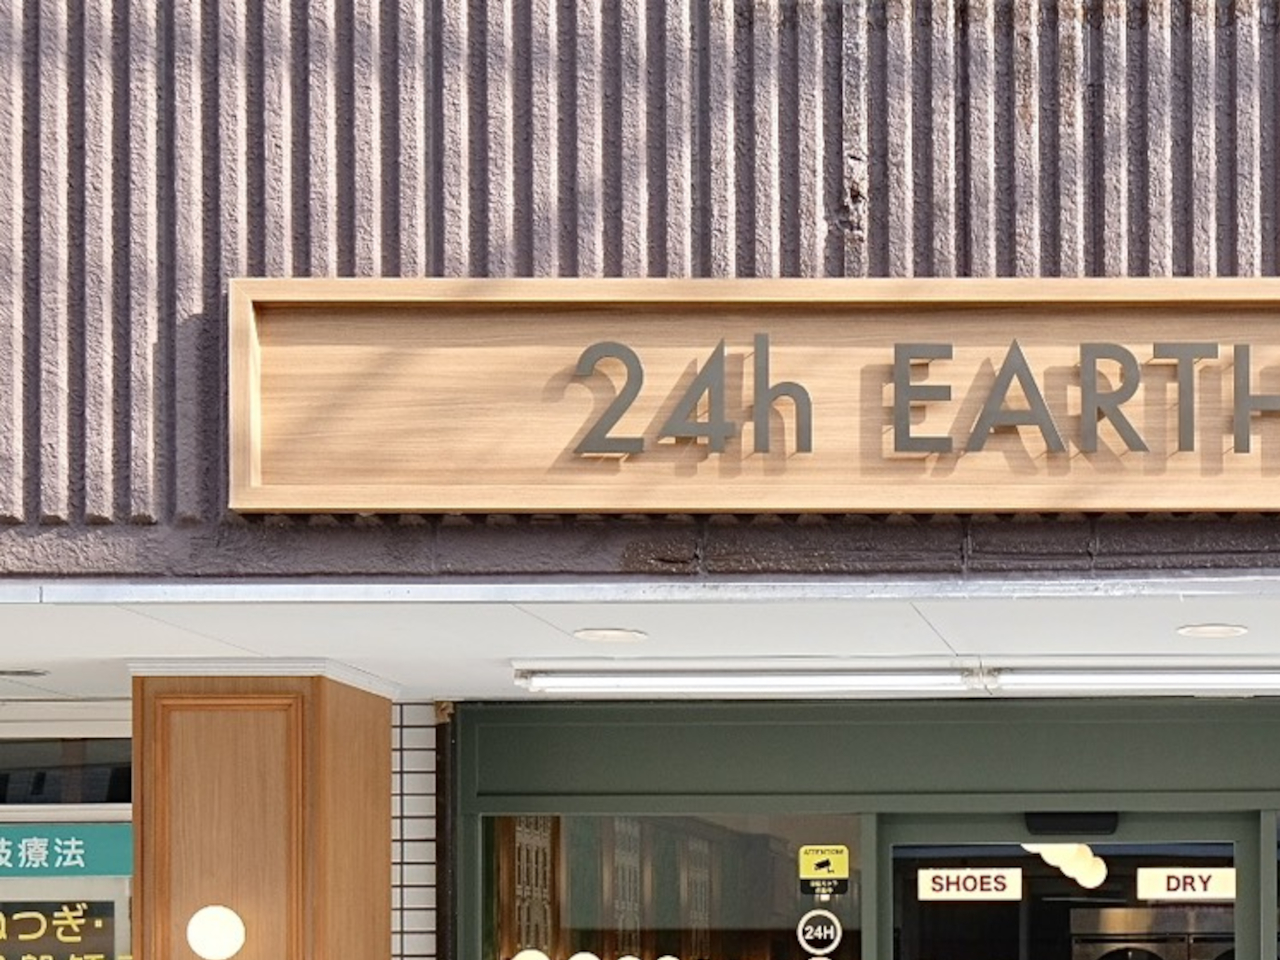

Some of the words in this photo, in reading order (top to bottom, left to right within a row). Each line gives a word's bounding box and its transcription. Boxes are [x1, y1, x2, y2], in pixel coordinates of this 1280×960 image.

[573, 333, 813, 454] 24h
[931, 875, 1007, 892] SHOES
[1166, 875, 1212, 892] DRY
[0, 903, 103, 943] つぎ・
[804, 926, 835, 939] 24H
